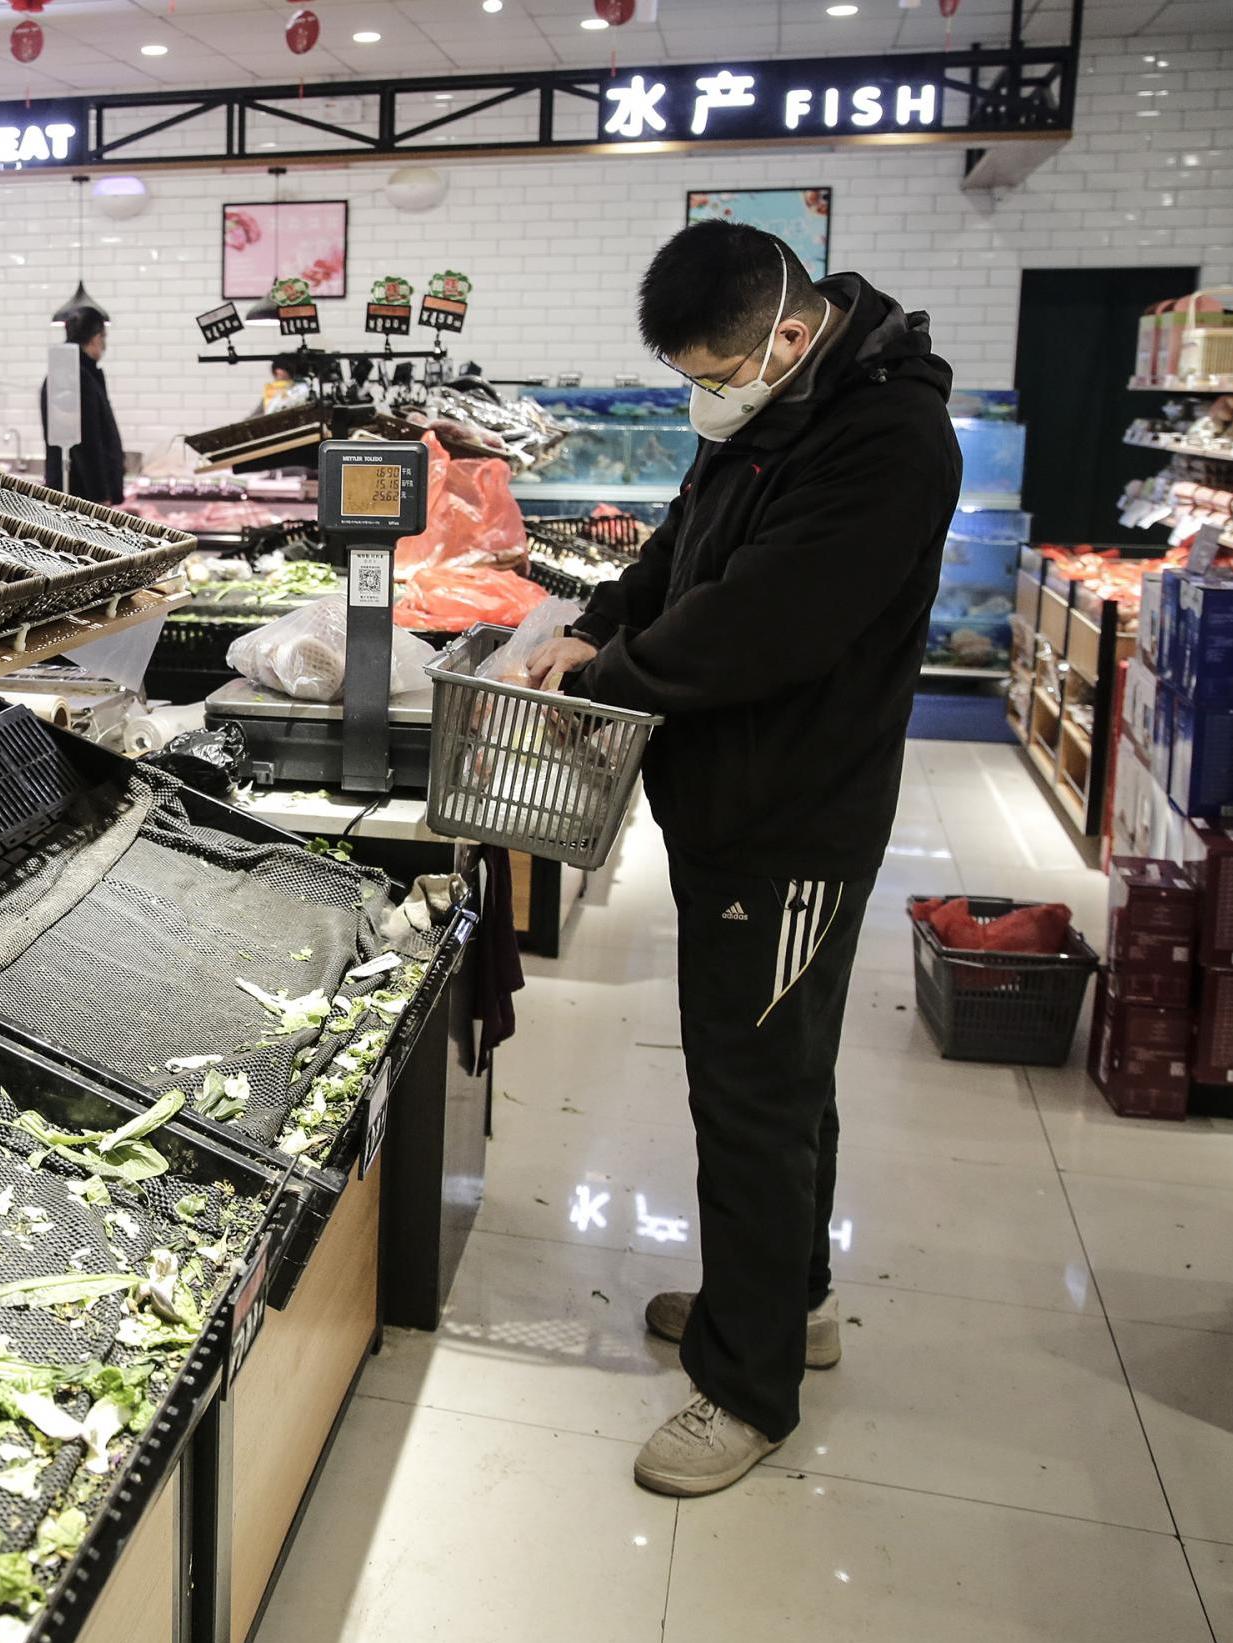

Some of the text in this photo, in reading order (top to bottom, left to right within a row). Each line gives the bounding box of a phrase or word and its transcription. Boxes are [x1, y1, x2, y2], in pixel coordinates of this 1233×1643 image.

[605, 71, 936, 137] 水产 FISH
[721, 912, 749, 920] adidas
